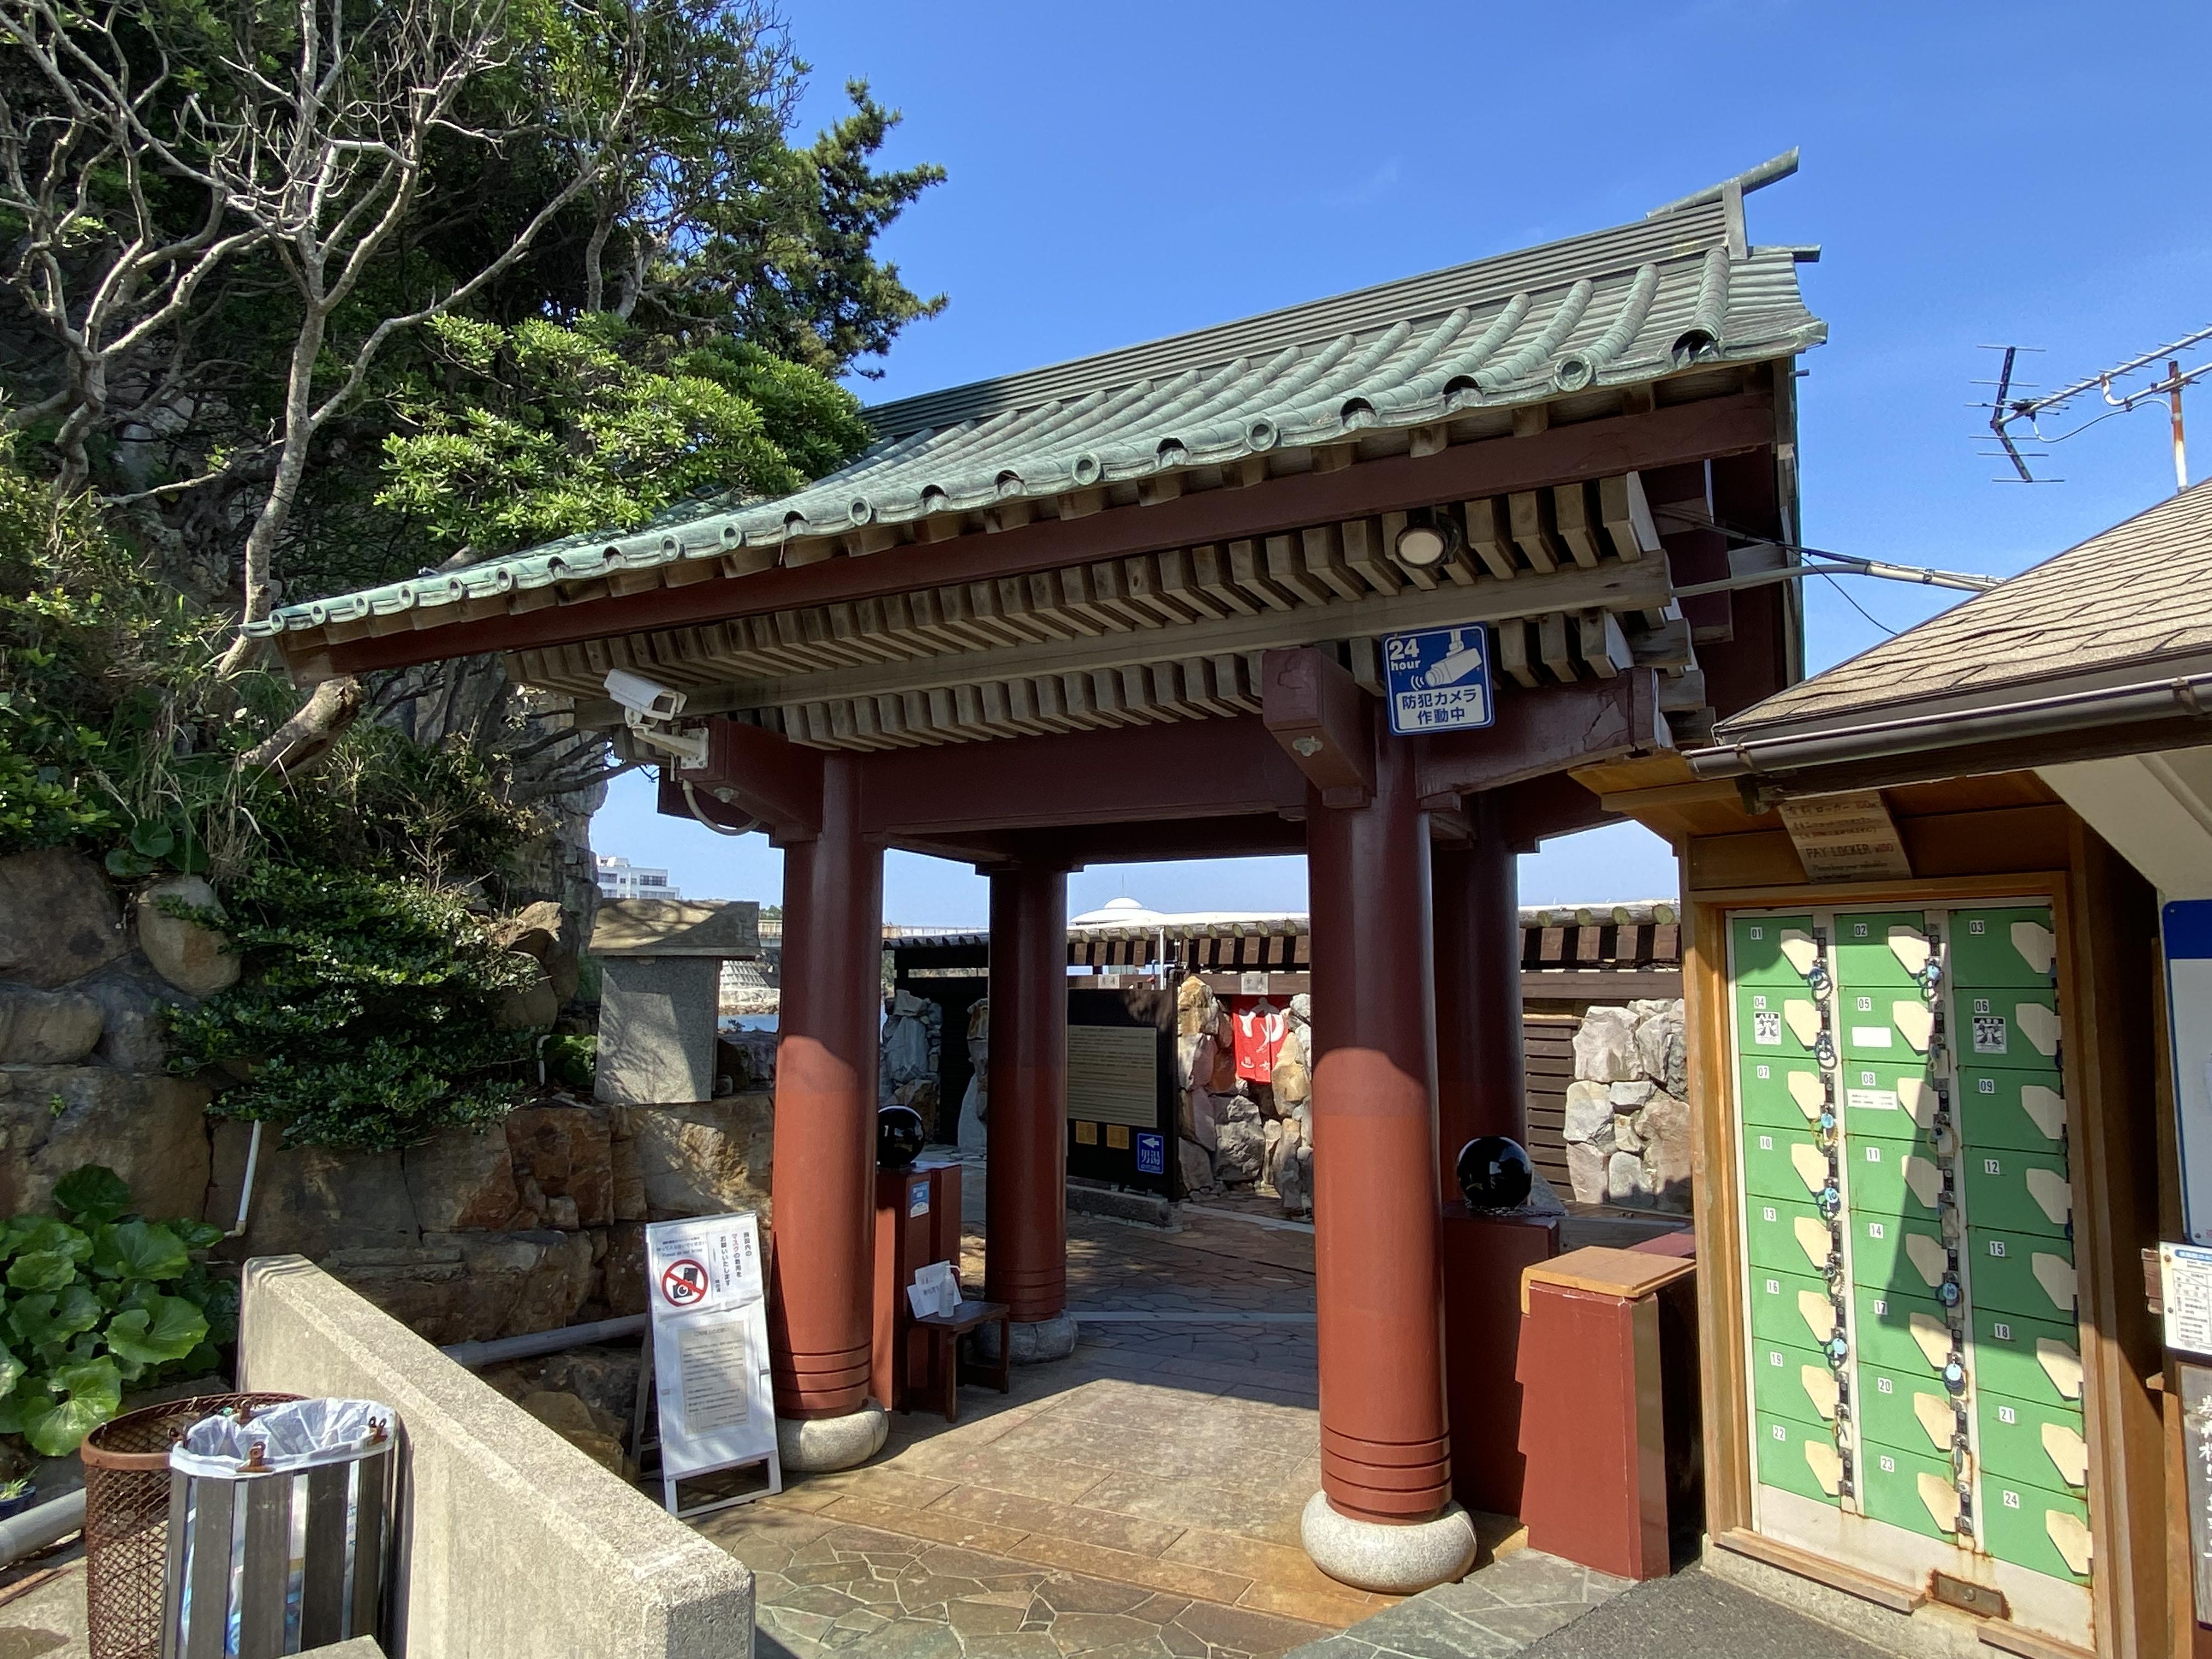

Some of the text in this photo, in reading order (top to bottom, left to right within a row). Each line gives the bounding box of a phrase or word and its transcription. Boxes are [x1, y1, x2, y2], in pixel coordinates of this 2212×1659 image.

[1389, 638, 1420, 661] 24
[1390, 659, 1421, 671] hour
[1402, 689, 1477, 710] 防犯カメラ
[1417, 707, 1465, 725] 作動中
[1805, 848, 1827, 859] PAY
[1752, 928, 1761, 938] 01
[1855, 925, 1866, 935] 02
[1971, 922, 1983, 933] 03
[1754, 997, 1764, 1007] 04
[1859, 998, 1870, 1009] 05
[1975, 1000, 1988, 1012] 06
[1758, 1067, 1768, 1076] 07
[1863, 1074, 1874, 1084] 08
[1980, 1080, 1993, 1092] 09
[1762, 1138, 1770, 1148] 10
[1869, 1149, 1878, 1159] 11
[1987, 1161, 1998, 1173] 12
[1765, 1209, 1774, 1220] 13
[1871, 1224, 1882, 1236] 14
[1991, 1243, 2004, 1255] 15
[1769, 1281, 1778, 1293] 16
[1876, 1301, 1886, 1314] 17
[1996, 1325, 2008, 1338] 18
[1772, 1353, 1781, 1365] 19
[1879, 1379, 1891, 1392] 20
[2001, 1408, 2012, 1421] 21
[1775, 1426, 1784, 1439] 22
[1882, 1458, 1893, 1470] 23
[2005, 1492, 2017, 1506] 24
